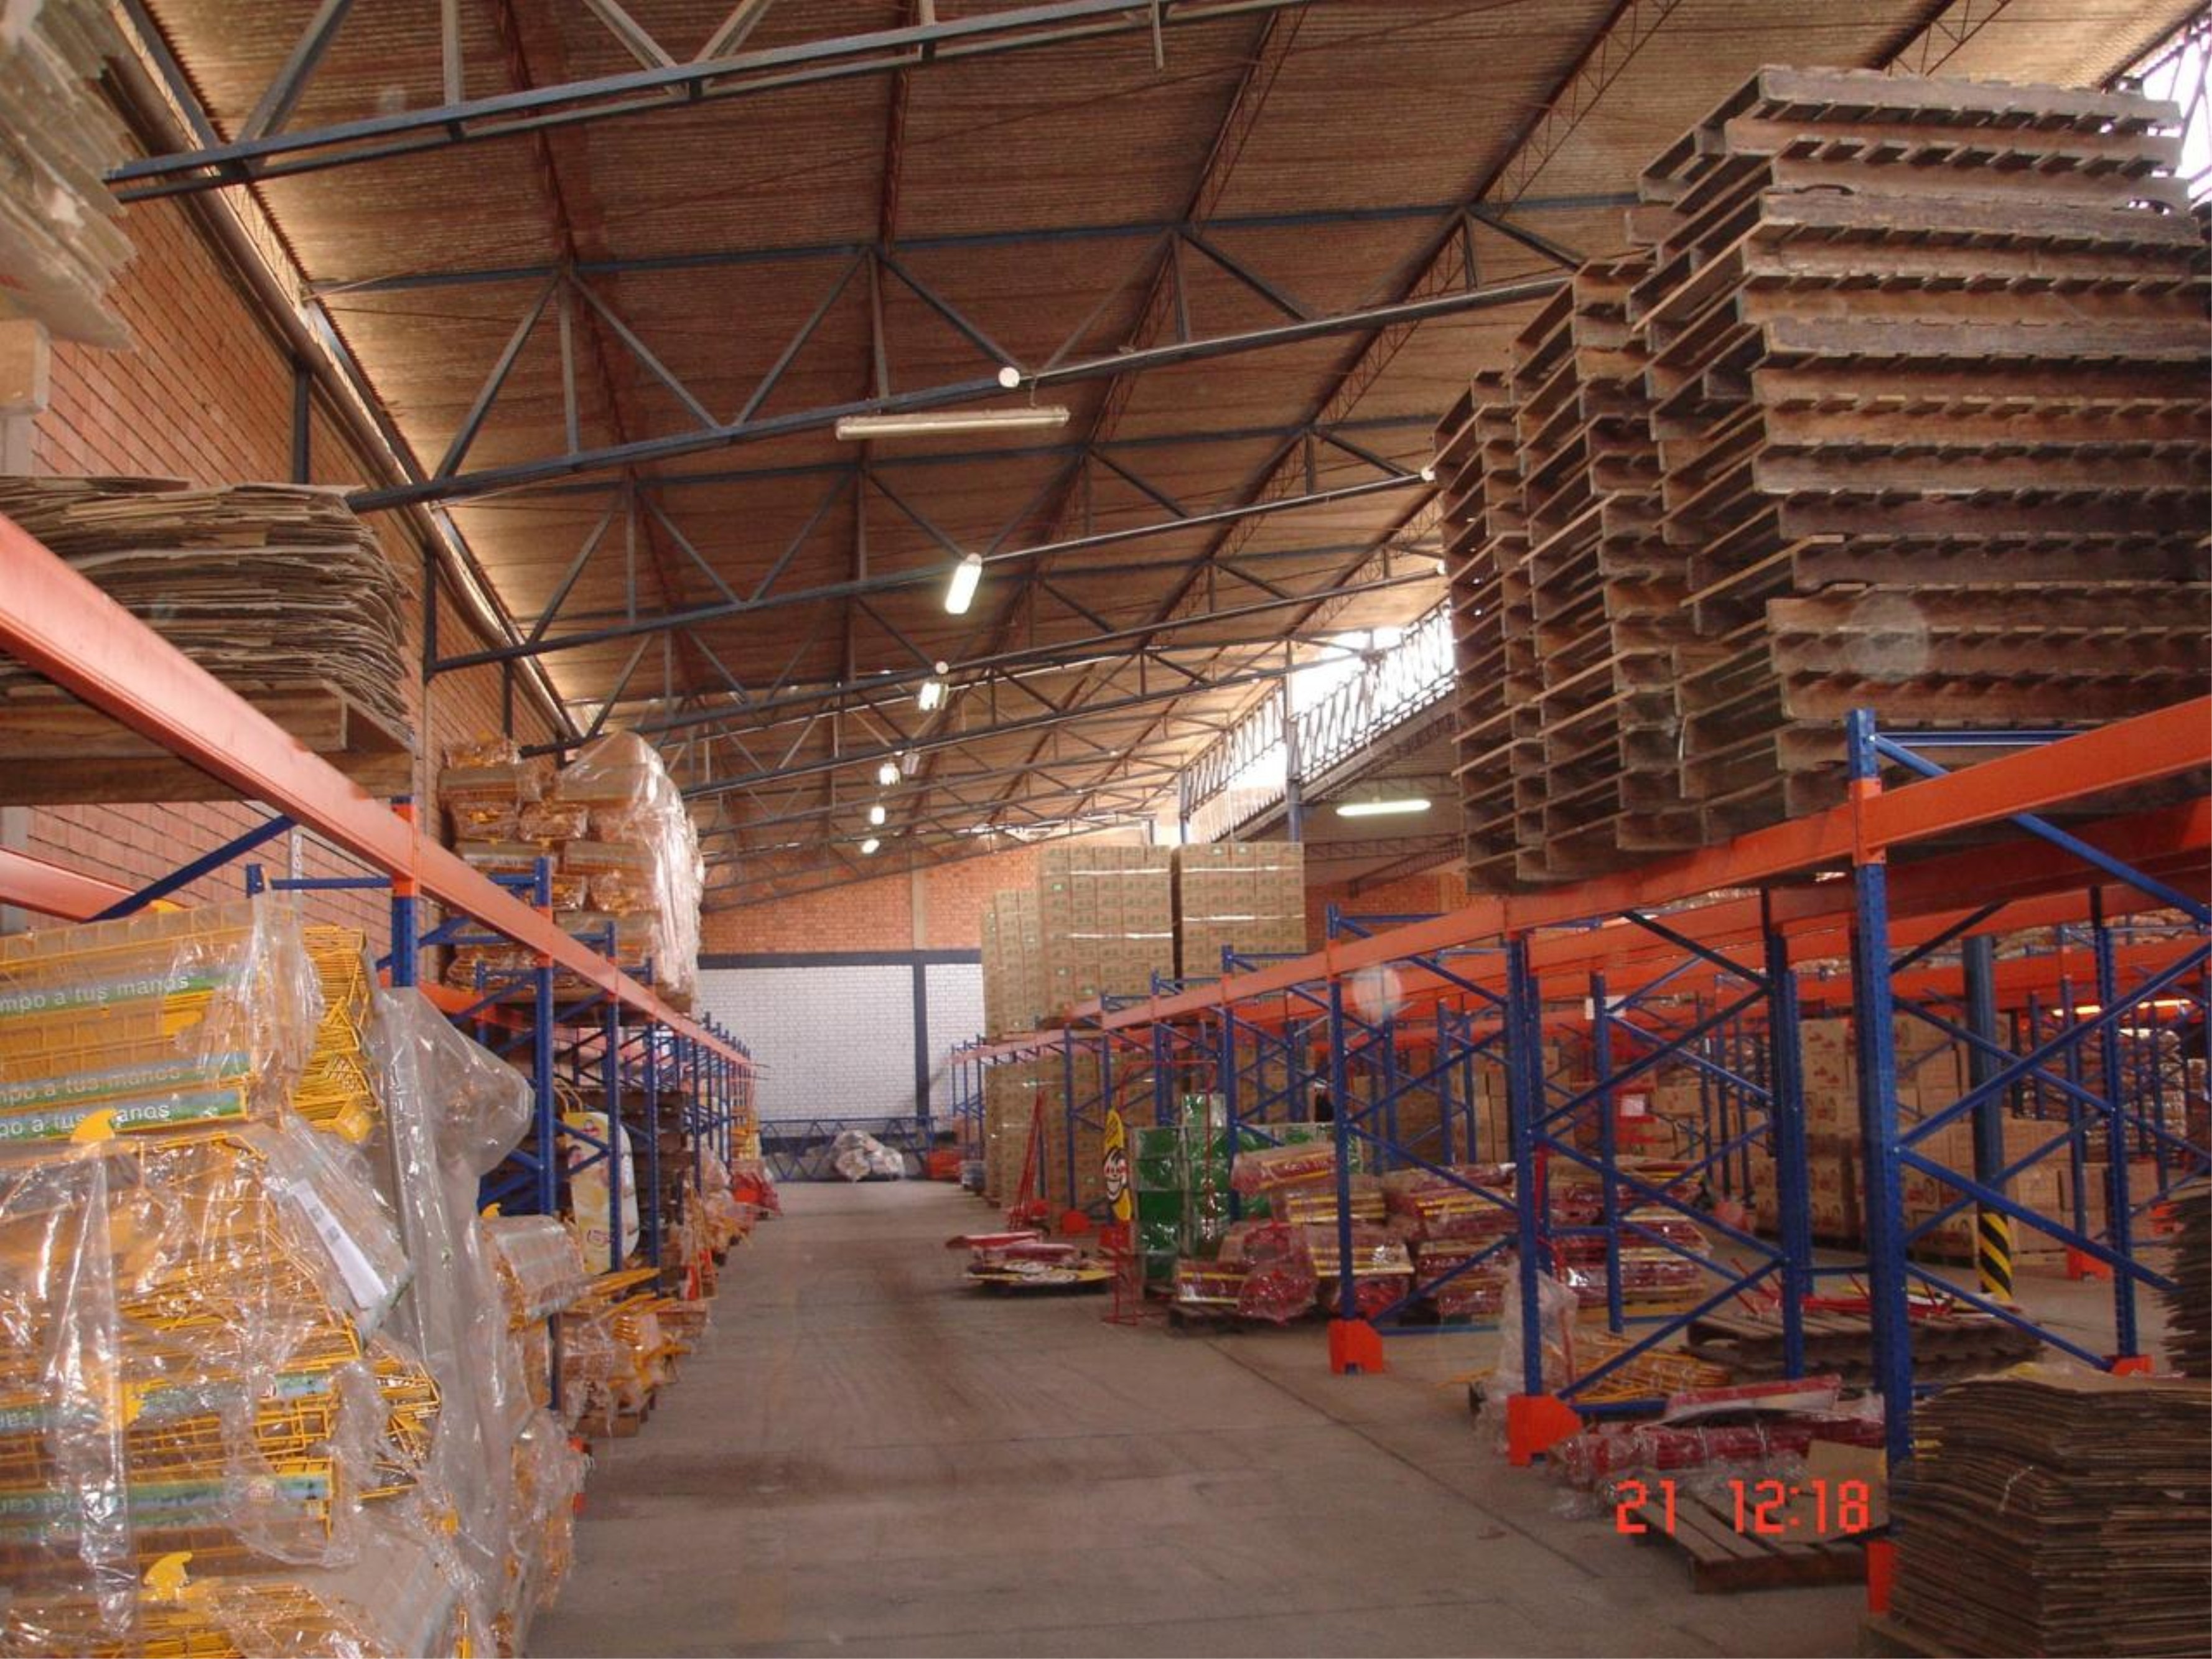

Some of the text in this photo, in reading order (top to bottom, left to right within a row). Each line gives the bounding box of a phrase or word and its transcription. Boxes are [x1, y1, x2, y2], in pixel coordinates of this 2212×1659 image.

[54, 992, 67, 1006] a
[75, 985, 109, 1003] tus
[116, 975, 189, 996] manos
[32, 1119, 44, 1133] a
[114, 1104, 170, 1123] anos
